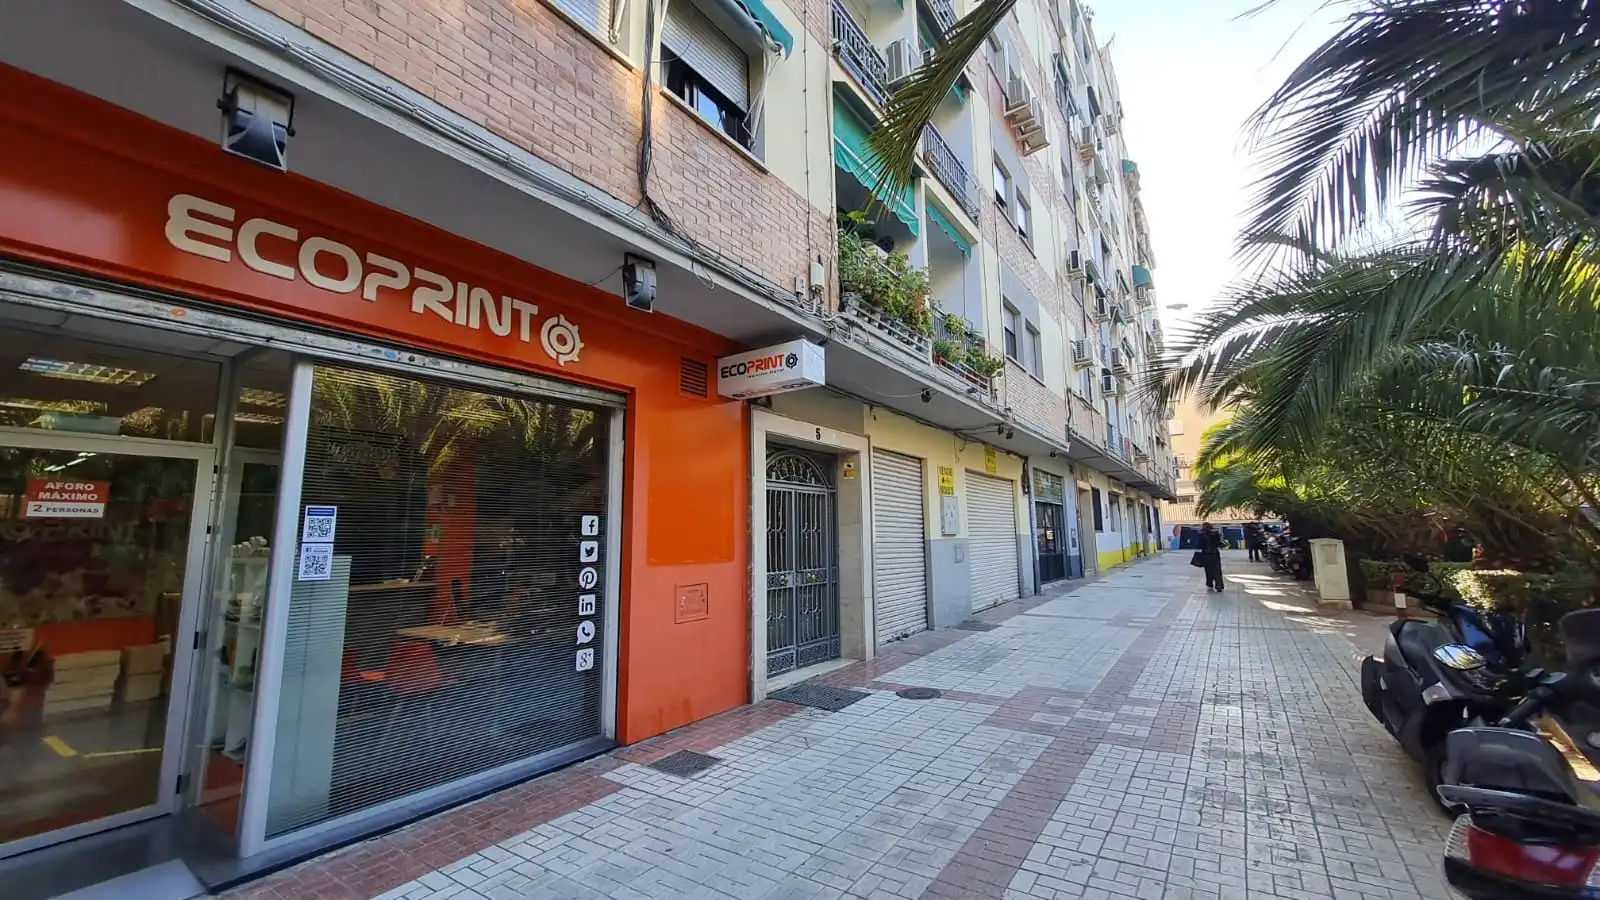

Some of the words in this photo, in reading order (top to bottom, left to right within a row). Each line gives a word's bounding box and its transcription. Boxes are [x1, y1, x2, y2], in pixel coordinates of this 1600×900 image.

[165, 193, 539, 342] ECOPRINT
[721, 354, 784, 378] ECOPRINT
[815, 427, 821, 440] 5
[45, 482, 95, 490] AFORO
[38, 491, 98, 500] MÁXIMO
[32, 504, 43, 512] 2
